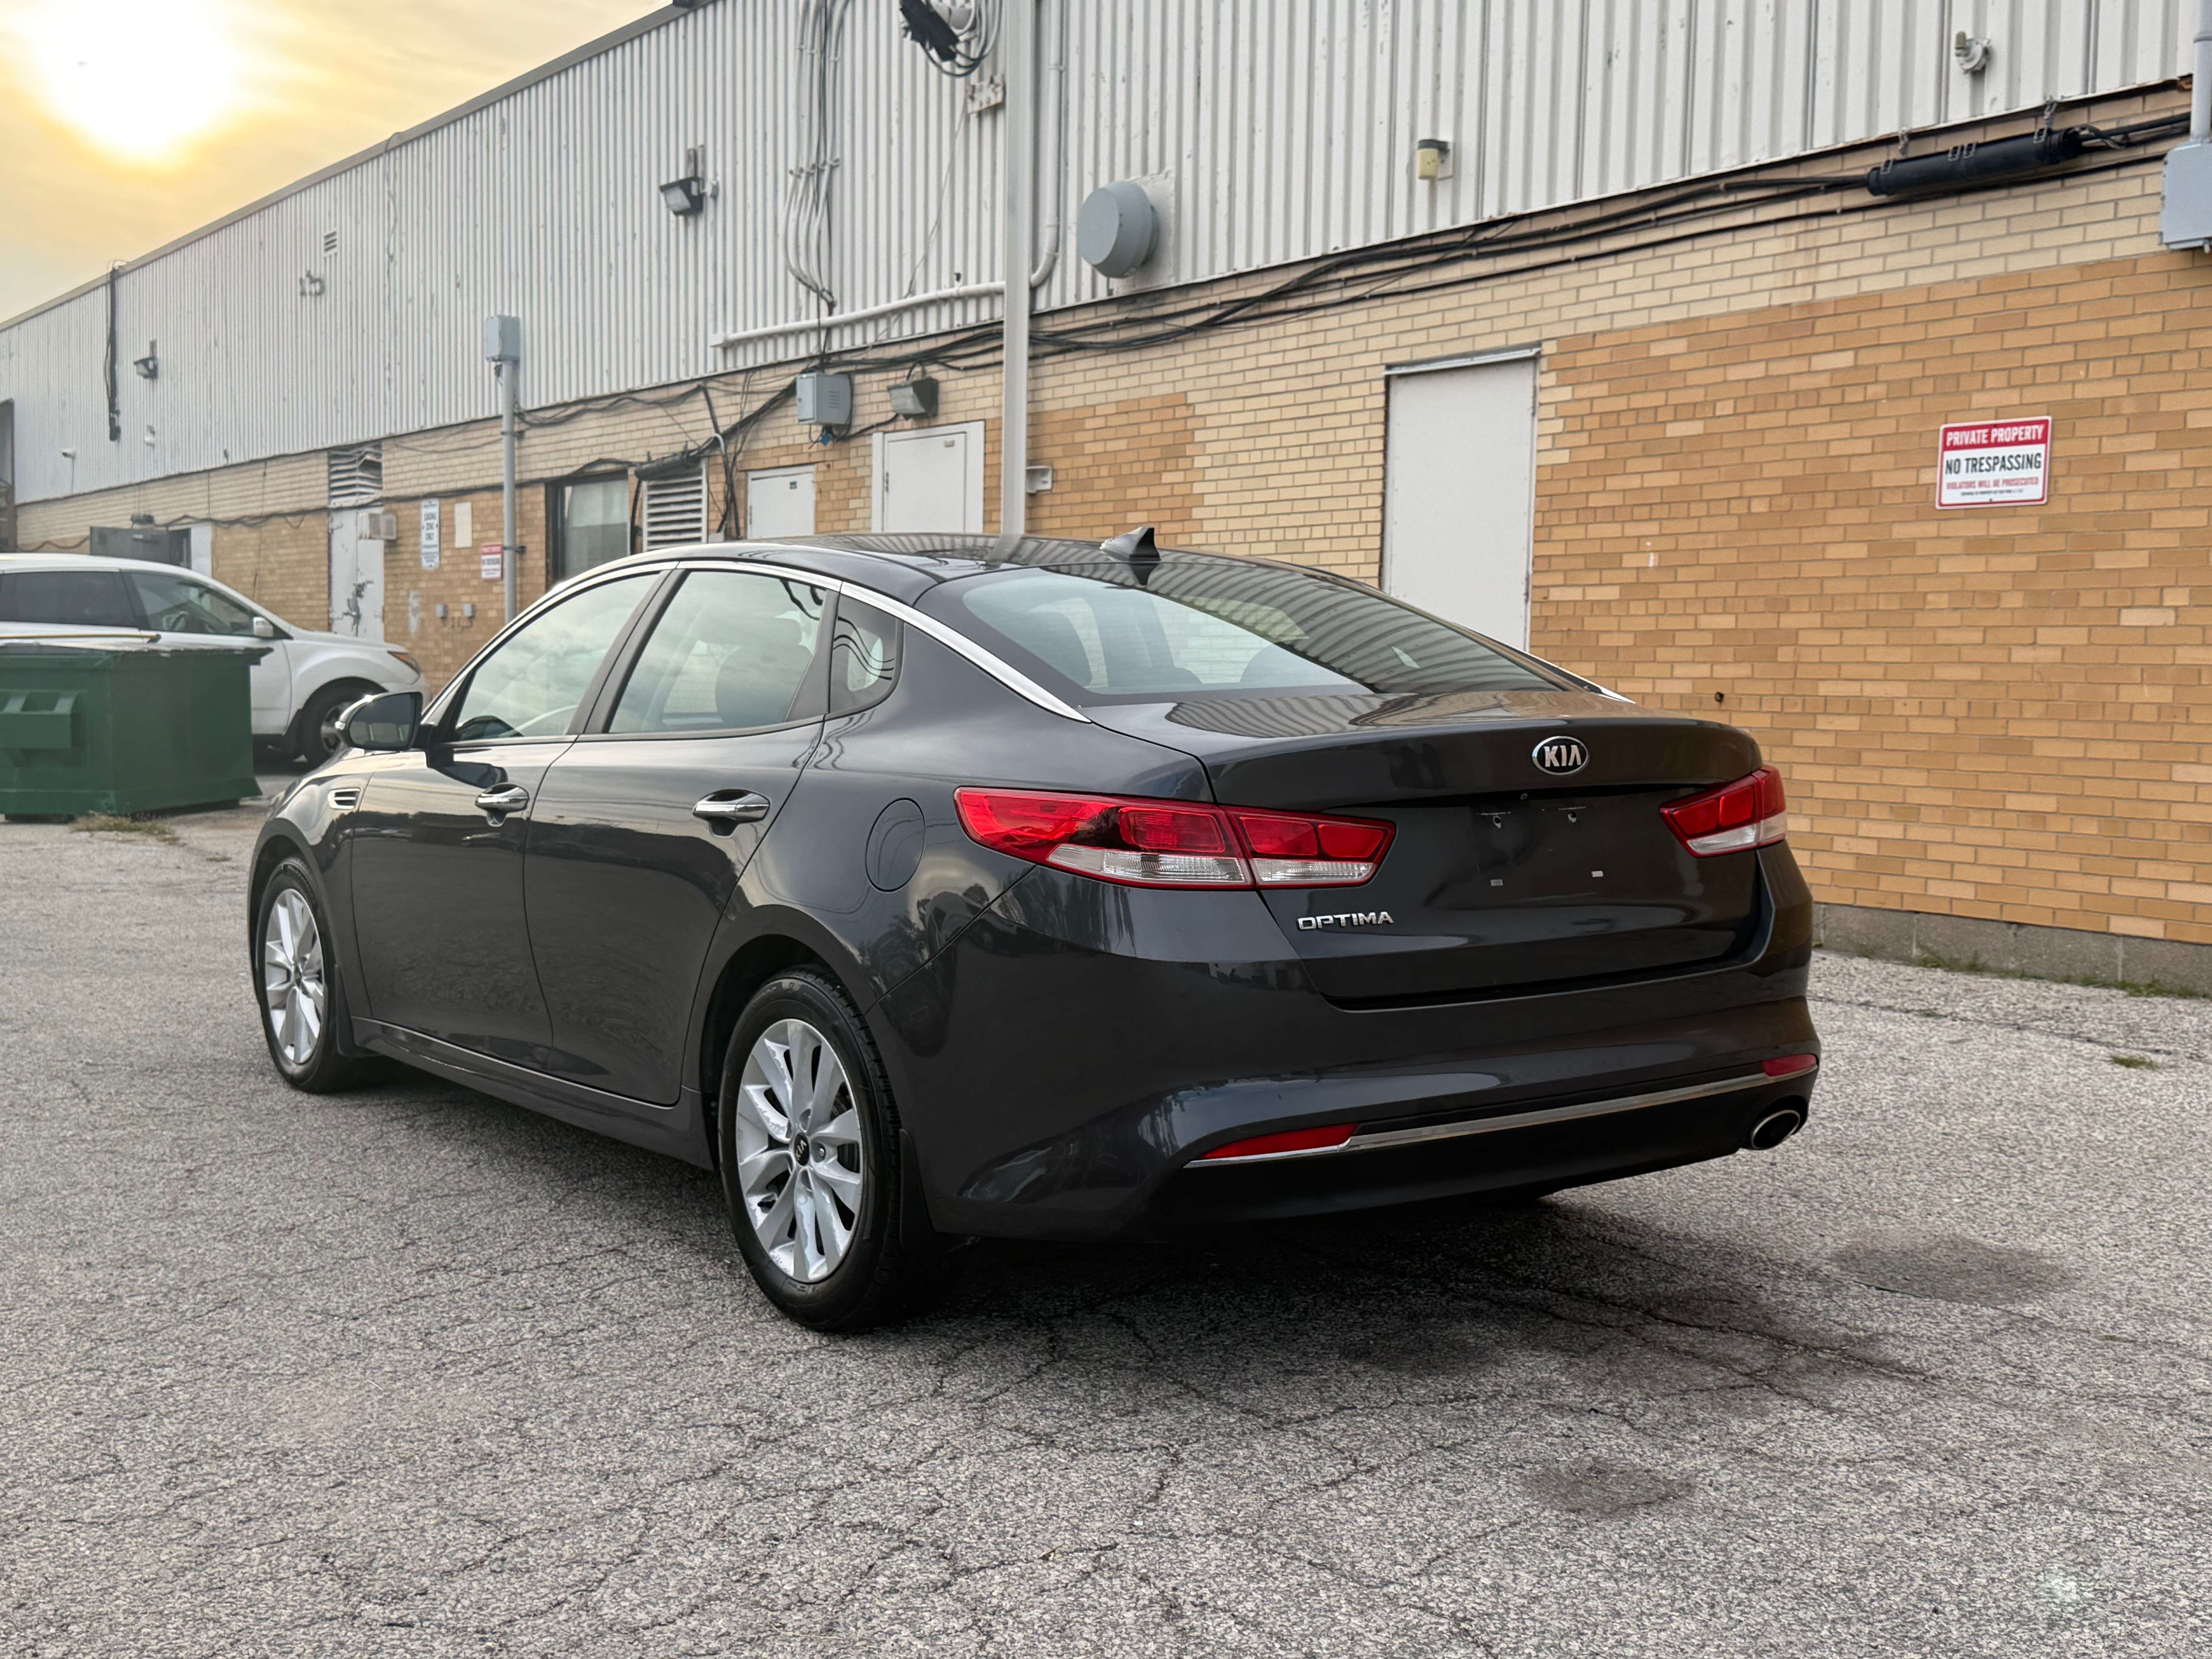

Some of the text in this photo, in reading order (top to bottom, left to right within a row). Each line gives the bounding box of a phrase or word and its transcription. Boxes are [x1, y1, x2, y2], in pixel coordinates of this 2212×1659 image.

[1947, 425, 2044, 446] PRIVATE PROPERTY
[1945, 453, 2041, 475] NO TRESPASSING
[1544, 745, 1581, 767] KIA
[1298, 911, 1394, 929] OPTIMA
[796, 1139, 807, 1161] KIA
